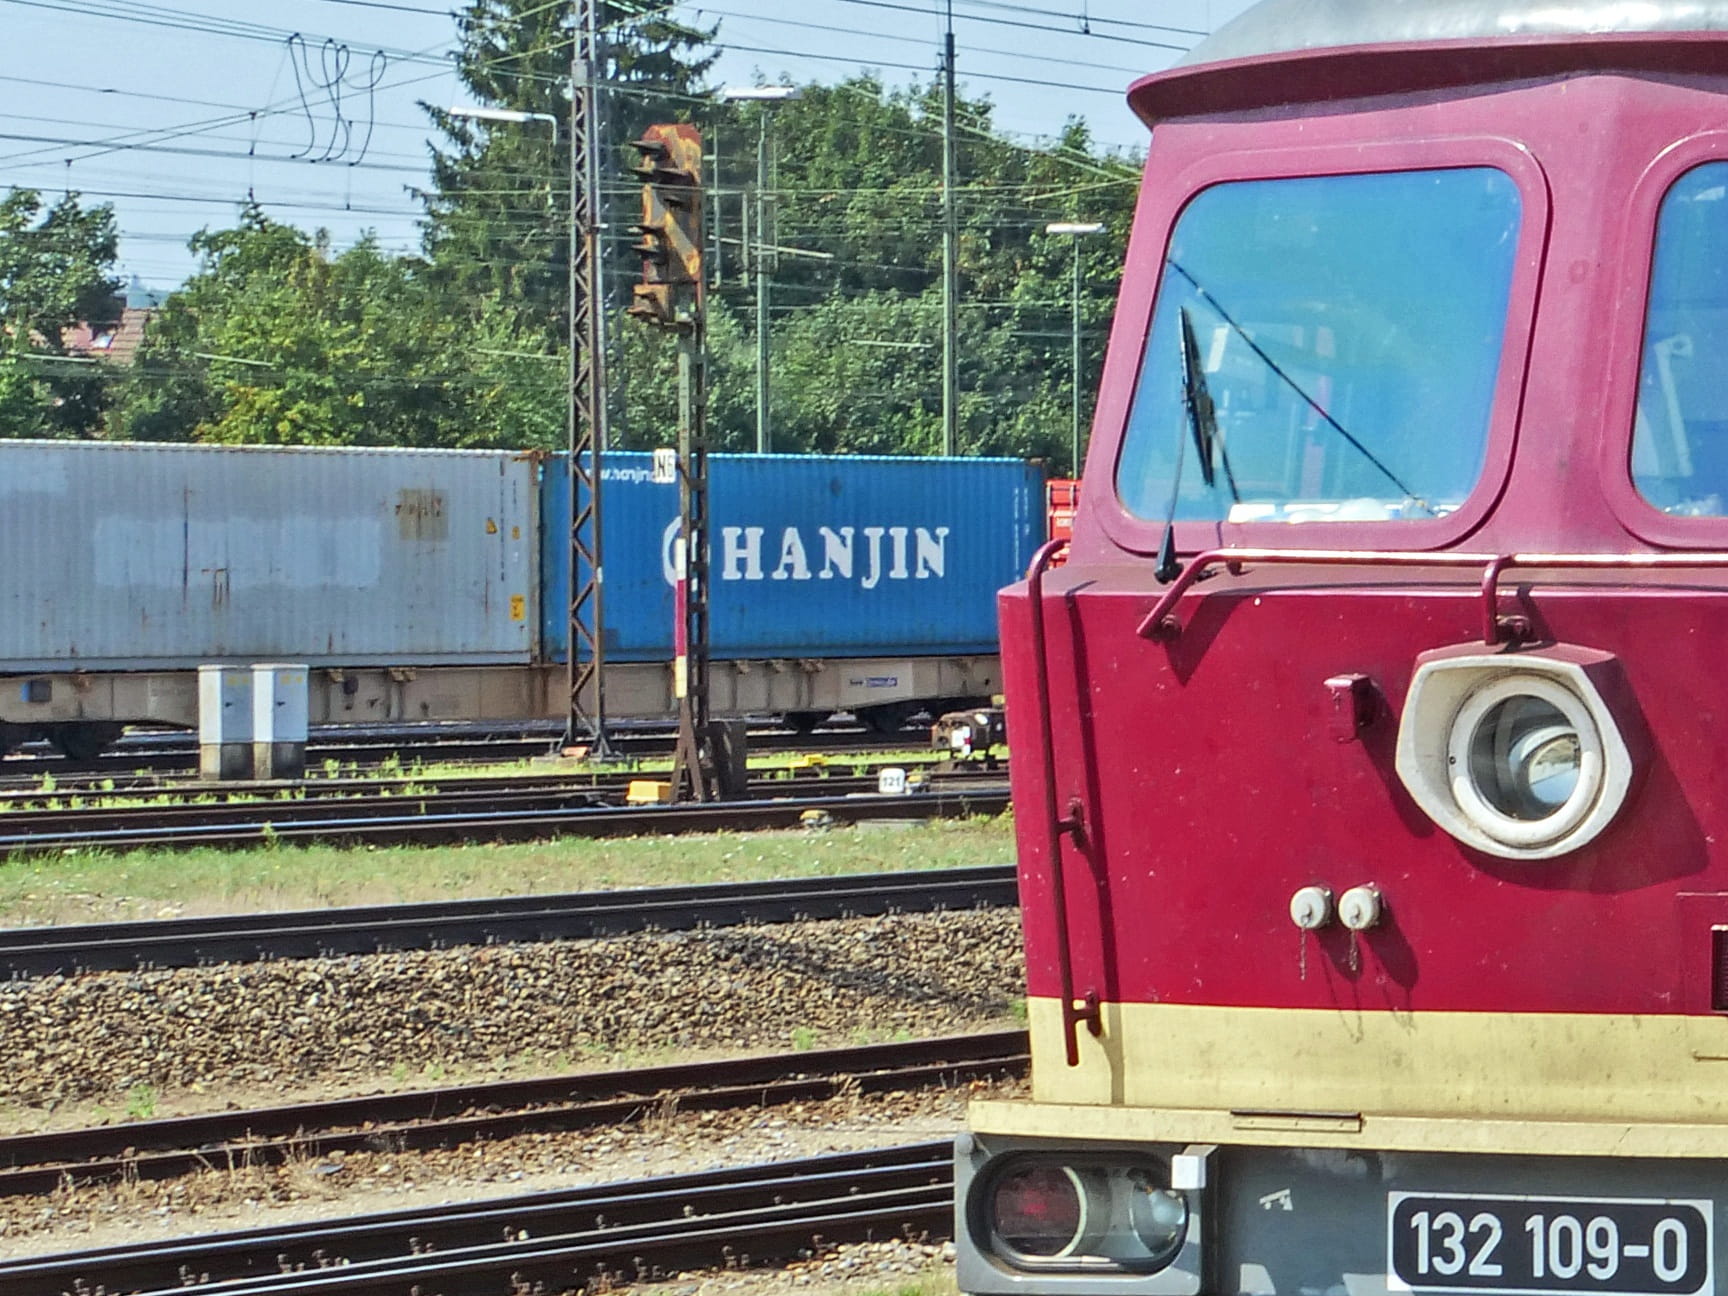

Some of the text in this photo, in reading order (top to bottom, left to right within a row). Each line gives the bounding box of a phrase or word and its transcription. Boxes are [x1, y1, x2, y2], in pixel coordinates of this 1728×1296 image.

[721, 526, 950, 589] HANJIN
[1410, 1211, 1688, 1282] 132 109-0
